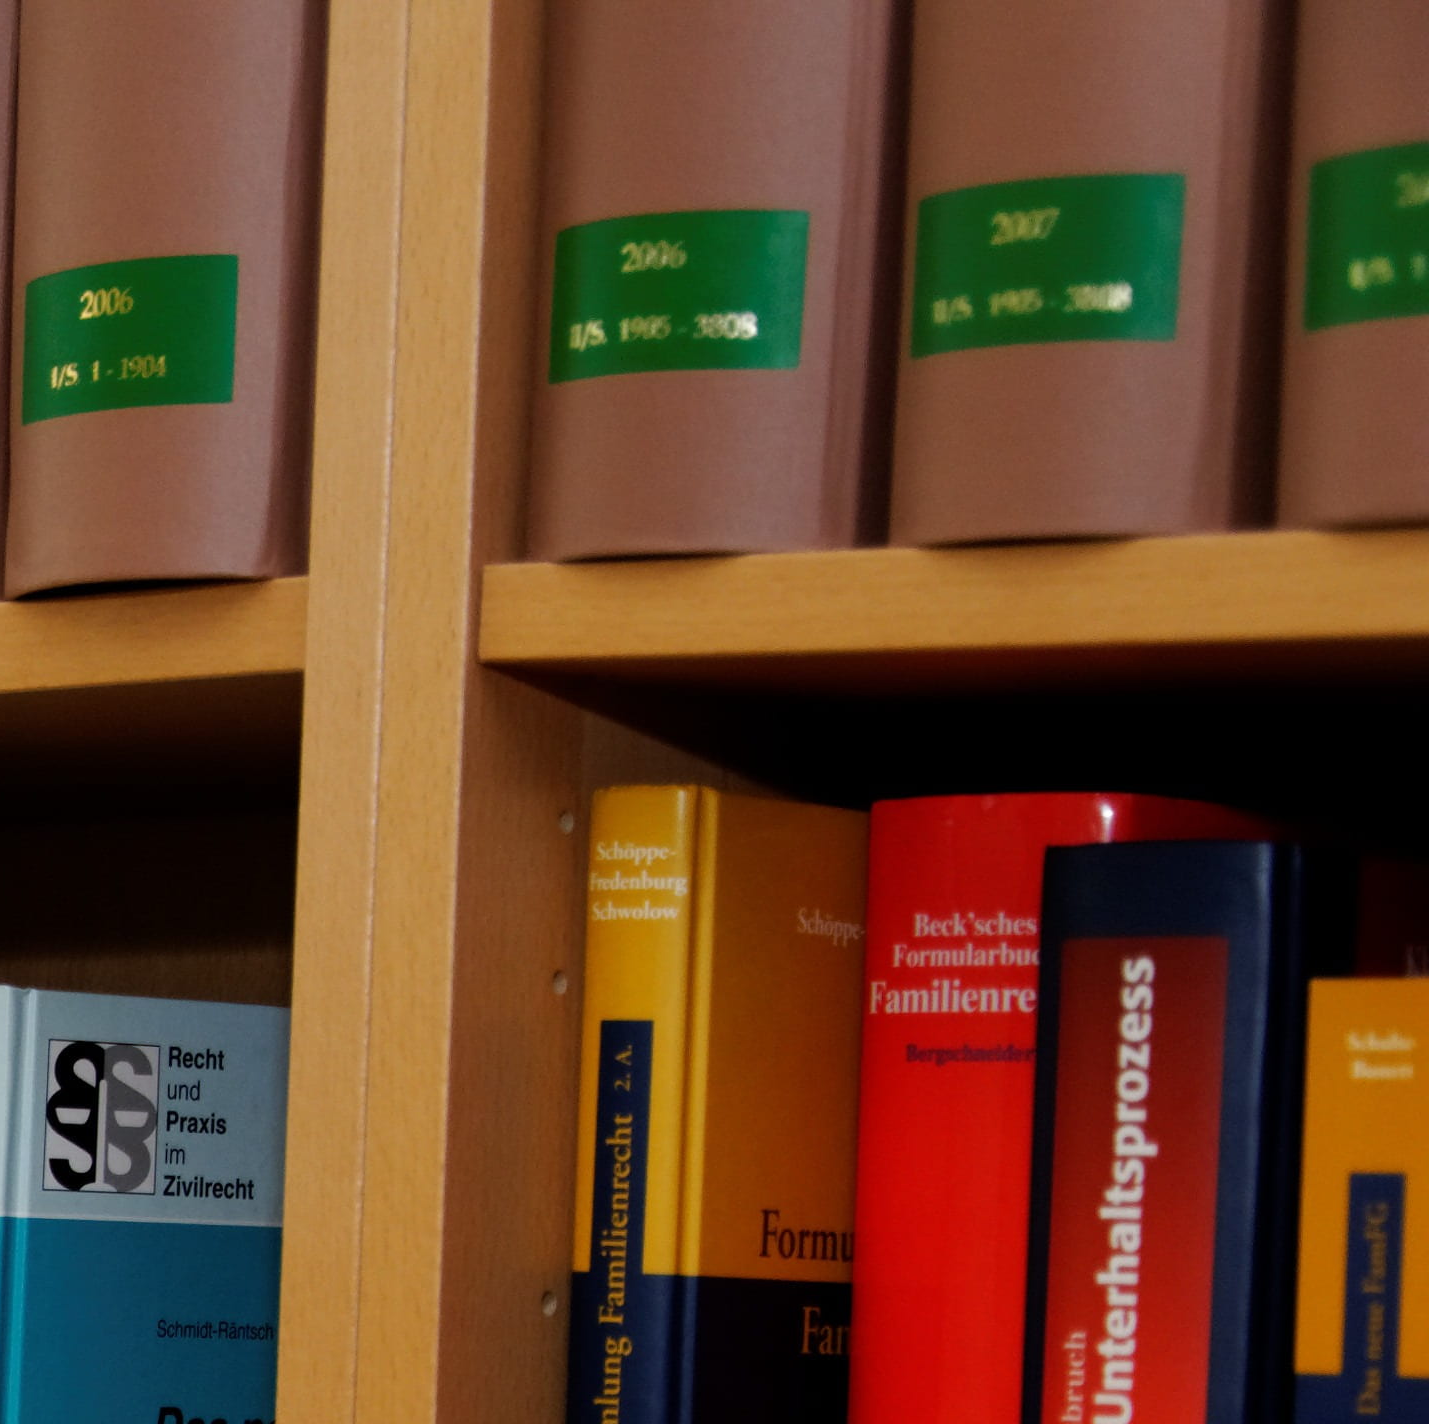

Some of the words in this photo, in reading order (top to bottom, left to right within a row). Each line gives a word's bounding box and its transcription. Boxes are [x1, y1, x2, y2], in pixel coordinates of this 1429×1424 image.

[79, 287, 134, 321] 2006
[120, 355, 167, 380] 1904
[595, 842, 677, 864] Schöppe-
[913, 911, 1038, 939] Beck'sches
[869, 978, 1037, 1017] Familienre
[168, 1045, 225, 1071] Recht
[167, 1080, 201, 1101] und
[165, 1110, 227, 1136] Praxis
[164, 1143, 186, 1165] im
[163, 1175, 255, 1201] Zivilrecht
[599, 1113, 634, 1326] Familienrecht
[157, 1319, 274, 1341] Schmidt-Räntsch
